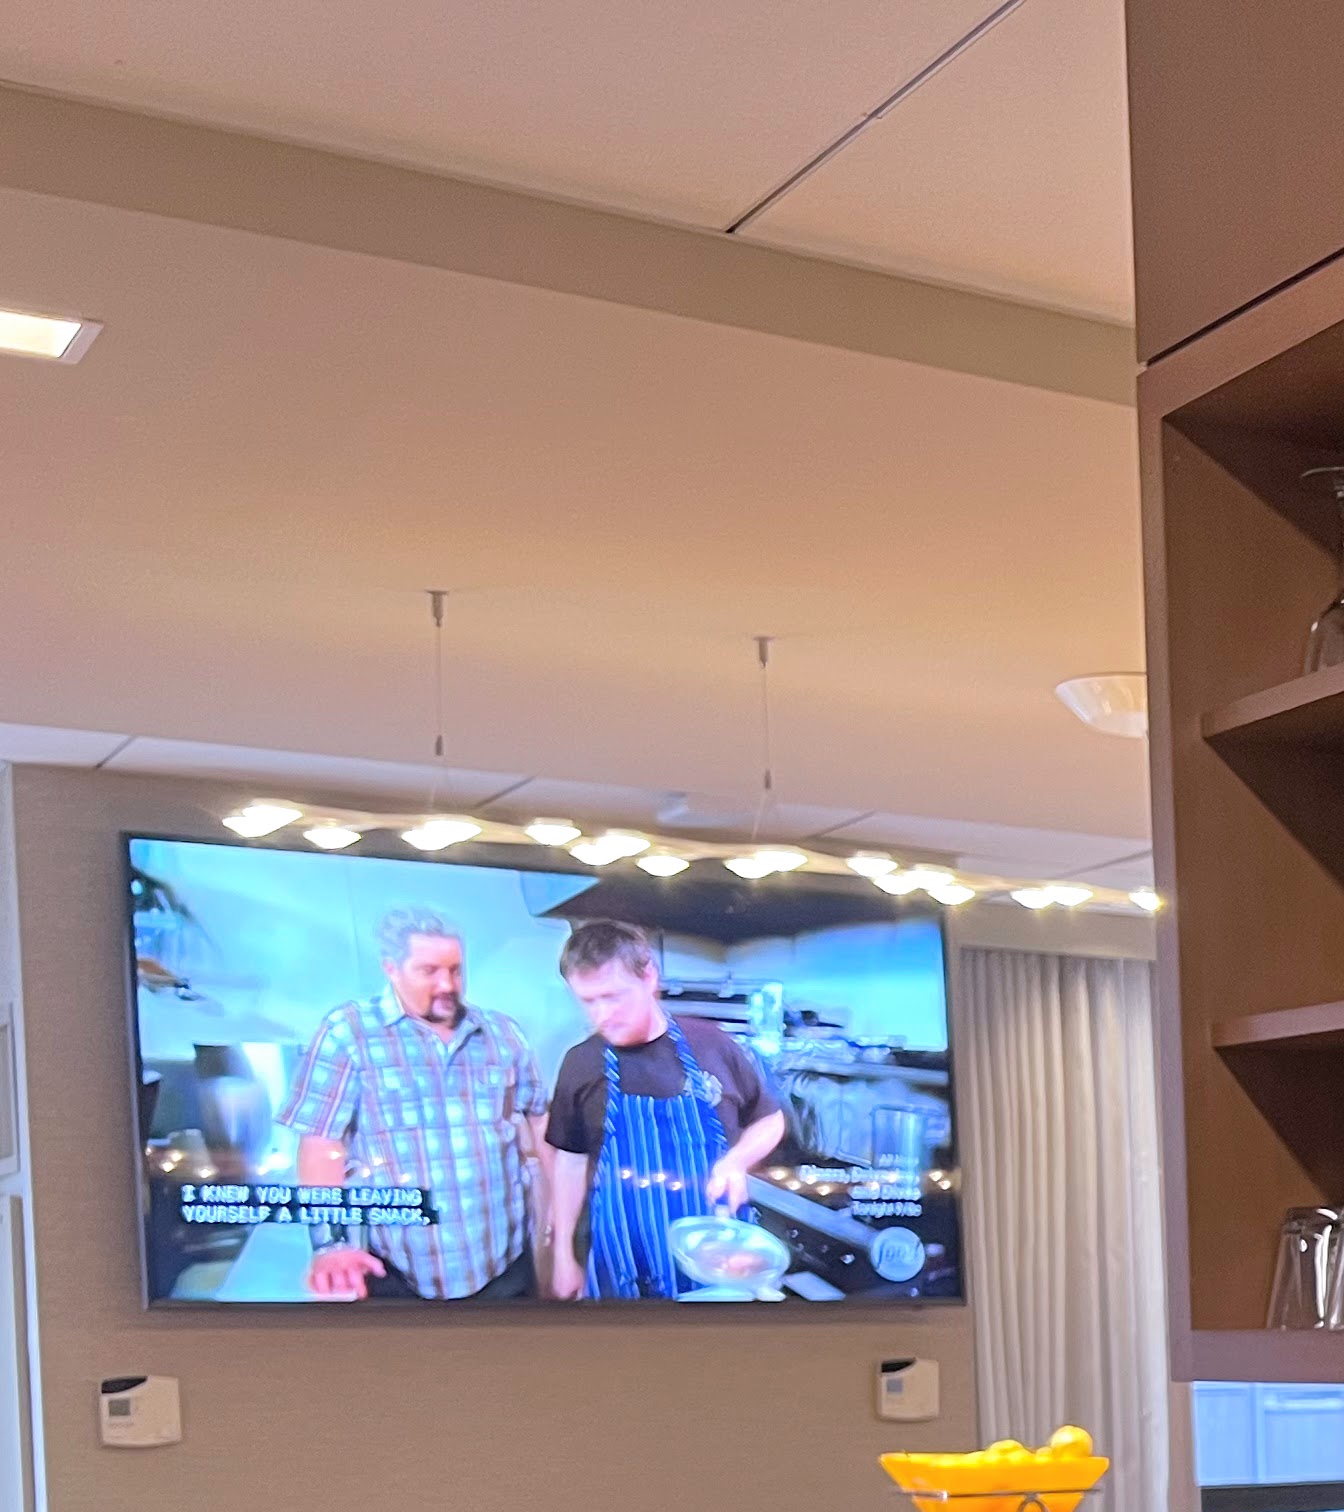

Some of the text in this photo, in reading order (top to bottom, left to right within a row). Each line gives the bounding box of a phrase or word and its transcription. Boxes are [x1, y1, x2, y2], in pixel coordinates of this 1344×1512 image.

[181, 1185, 423, 1207] I KNEW YOU WERE LEAVING
[182, 1204, 271, 1224] YOURSELF
[277, 1206, 293, 1223] A
[300, 1206, 363, 1225] LITTLE
